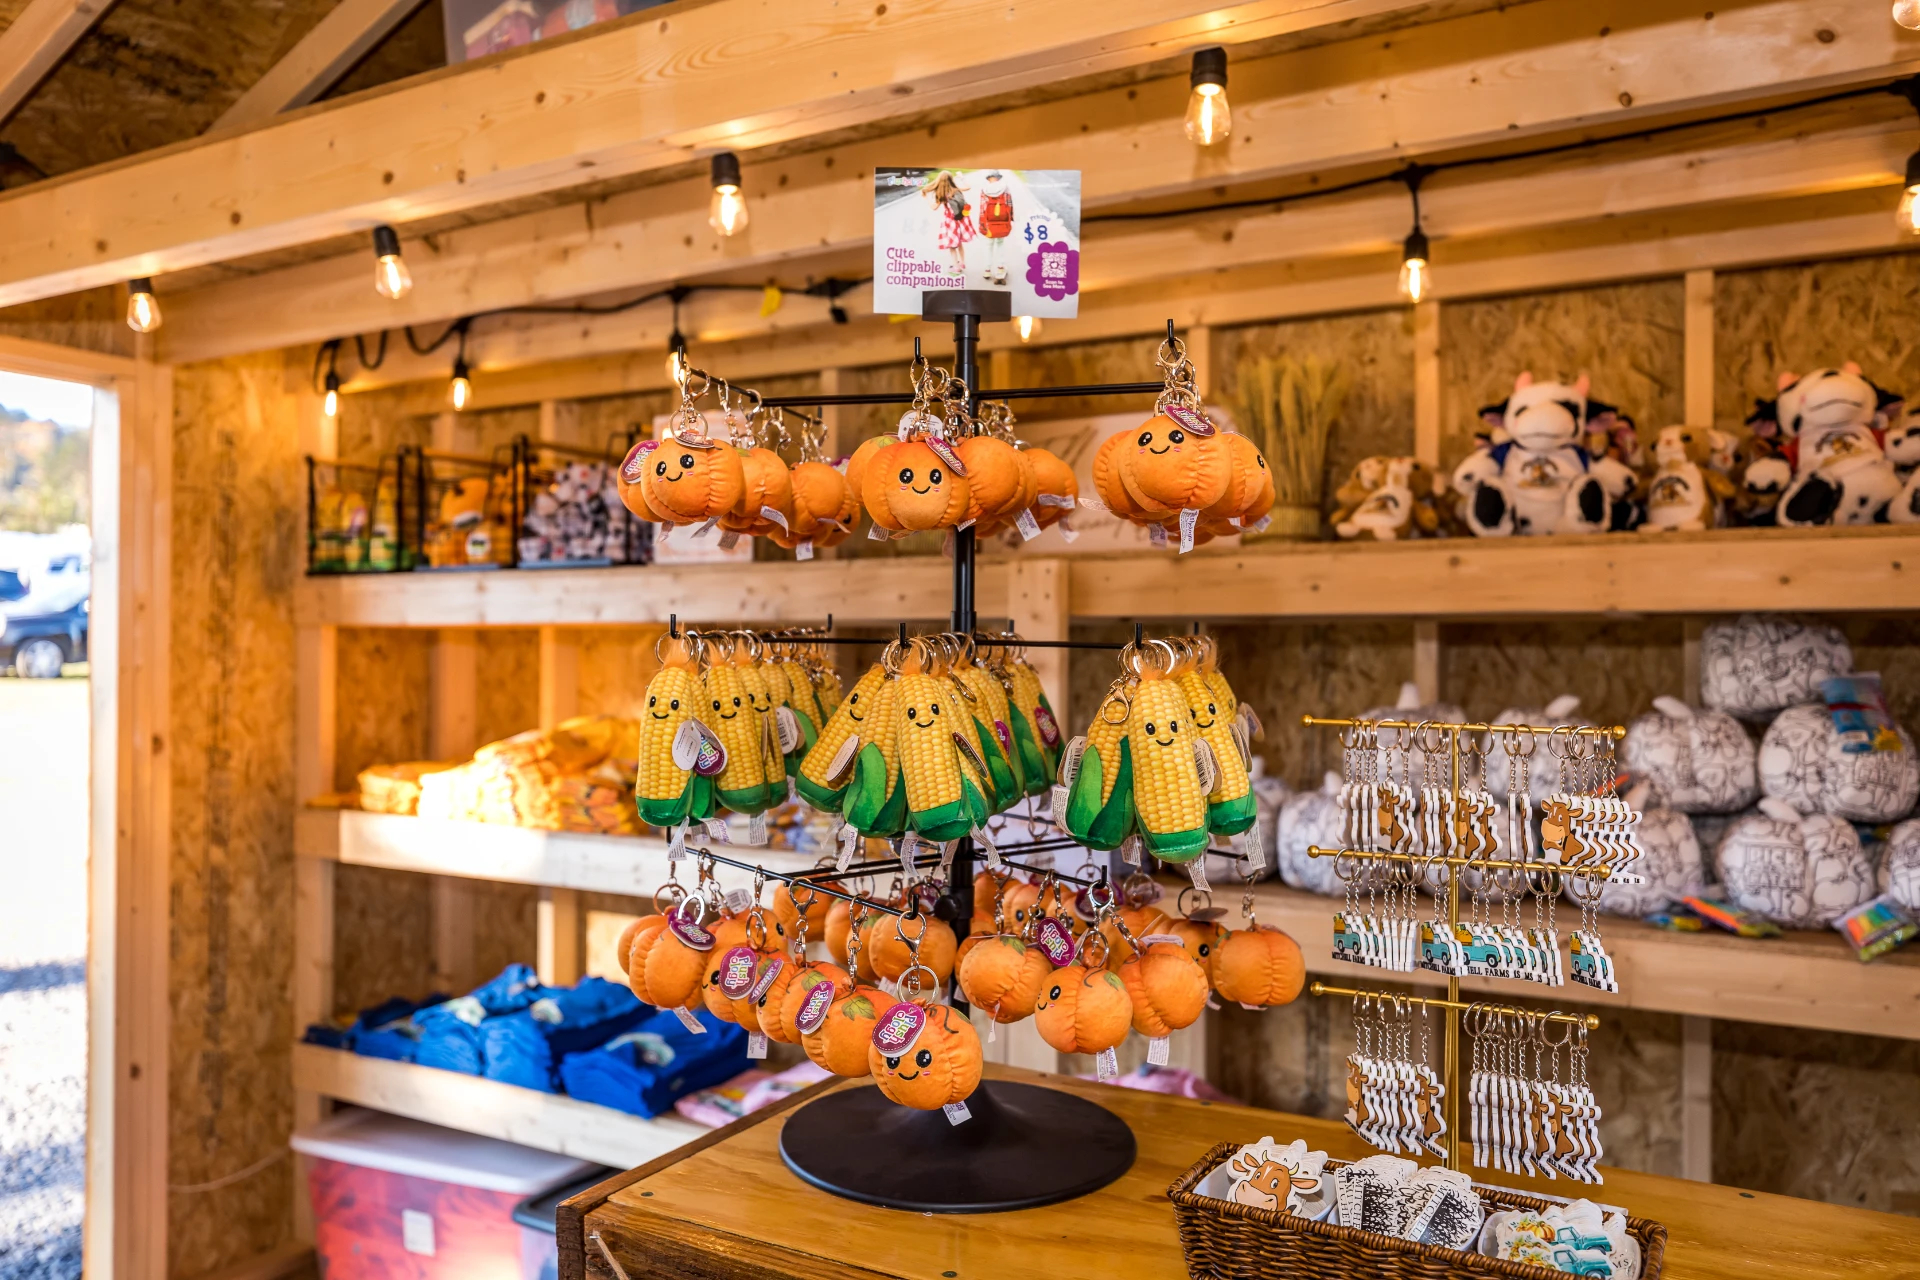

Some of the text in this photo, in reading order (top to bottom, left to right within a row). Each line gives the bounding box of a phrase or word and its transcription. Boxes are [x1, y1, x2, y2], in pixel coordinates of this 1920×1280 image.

[886, 247, 915, 259] Cute
[886, 260, 941, 275] clippable
[886, 275, 965, 289] companions!
[1041, 930, 1064, 961] Plush
[1046, 922, 1069, 952] ology
[725, 956, 740, 989] ology
[736, 956, 752, 987] Plush
[1484, 967, 1510, 978] FARMS
[800, 990, 821, 1024] ology
[808, 989, 829, 1021] Plush
[880, 1011, 906, 1042] ology
[889, 1014, 917, 1044] Plush
